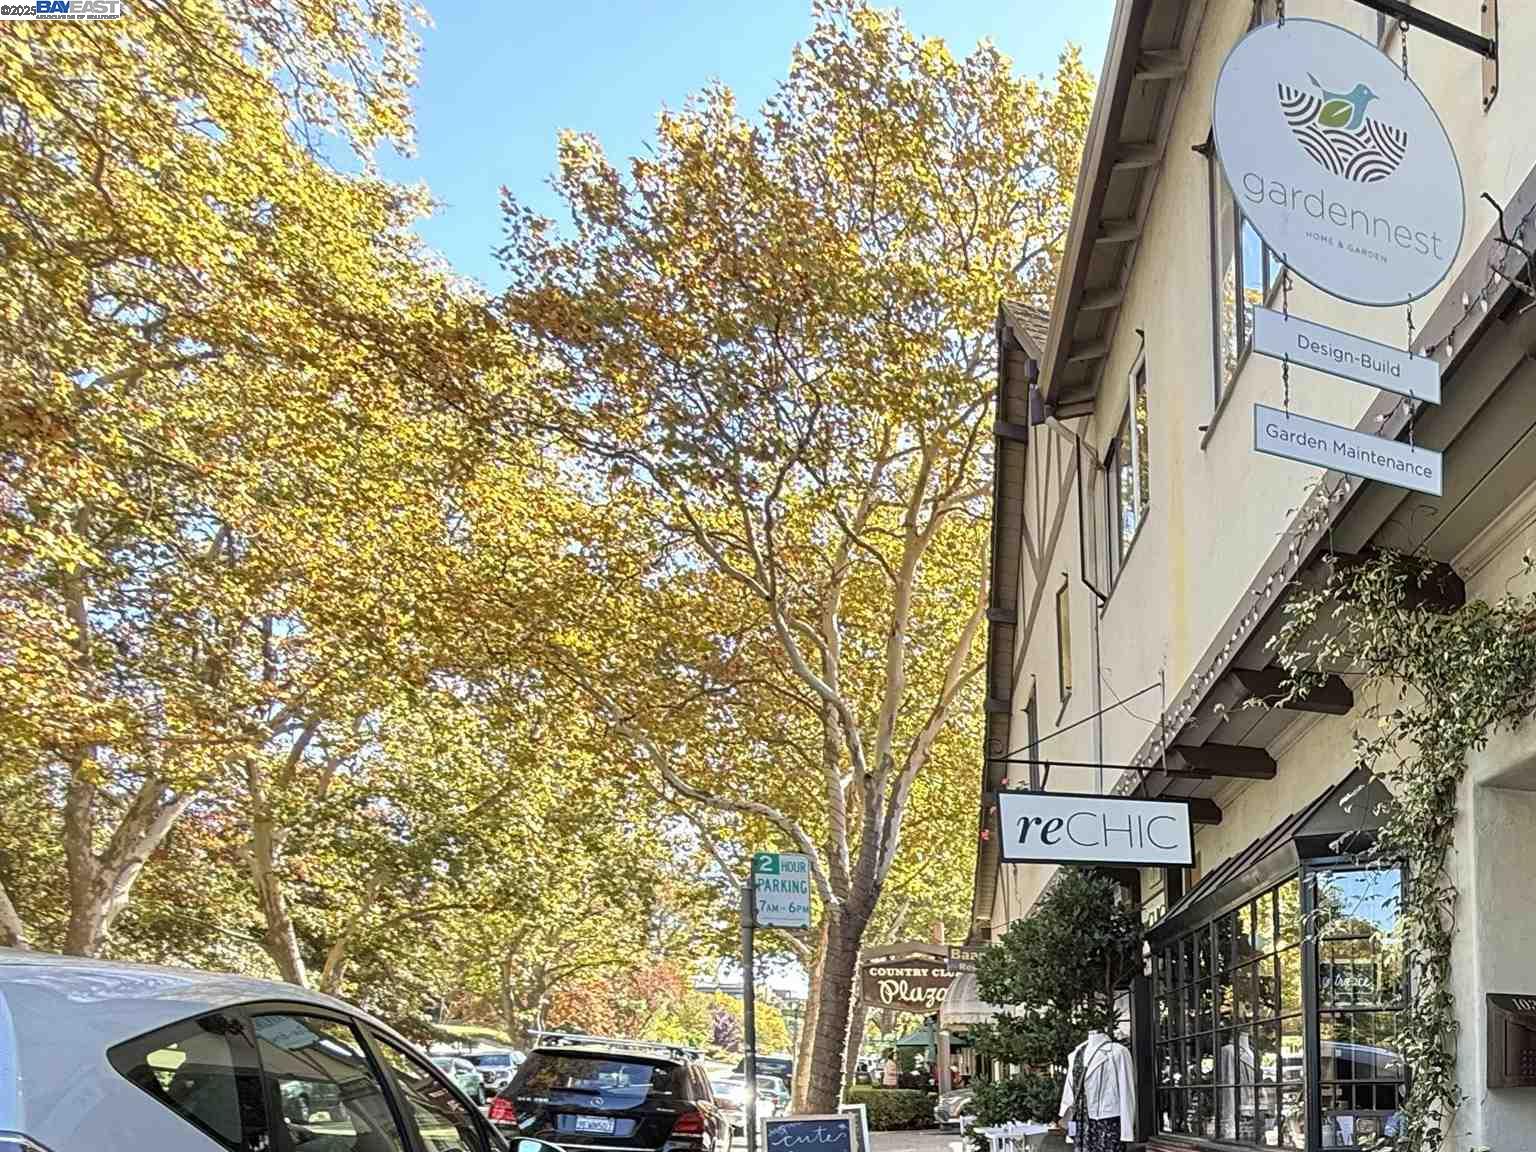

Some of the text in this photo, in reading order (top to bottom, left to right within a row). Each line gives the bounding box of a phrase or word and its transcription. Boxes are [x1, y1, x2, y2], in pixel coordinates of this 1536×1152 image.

[1243, 171, 1443, 260] gardennest
[1306, 231, 1333, 245] HOME
[1347, 243, 1388, 263] GARDEN
[1297, 334, 1401, 378] Design-Build
[1266, 423, 1433, 478] Garden Maintenance
[1016, 811, 1179, 849] reCHIC
[759, 855, 807, 872] 2 HOUR
[757, 879, 808, 895] PARKING
[869, 967, 929, 977] COUNTRY
